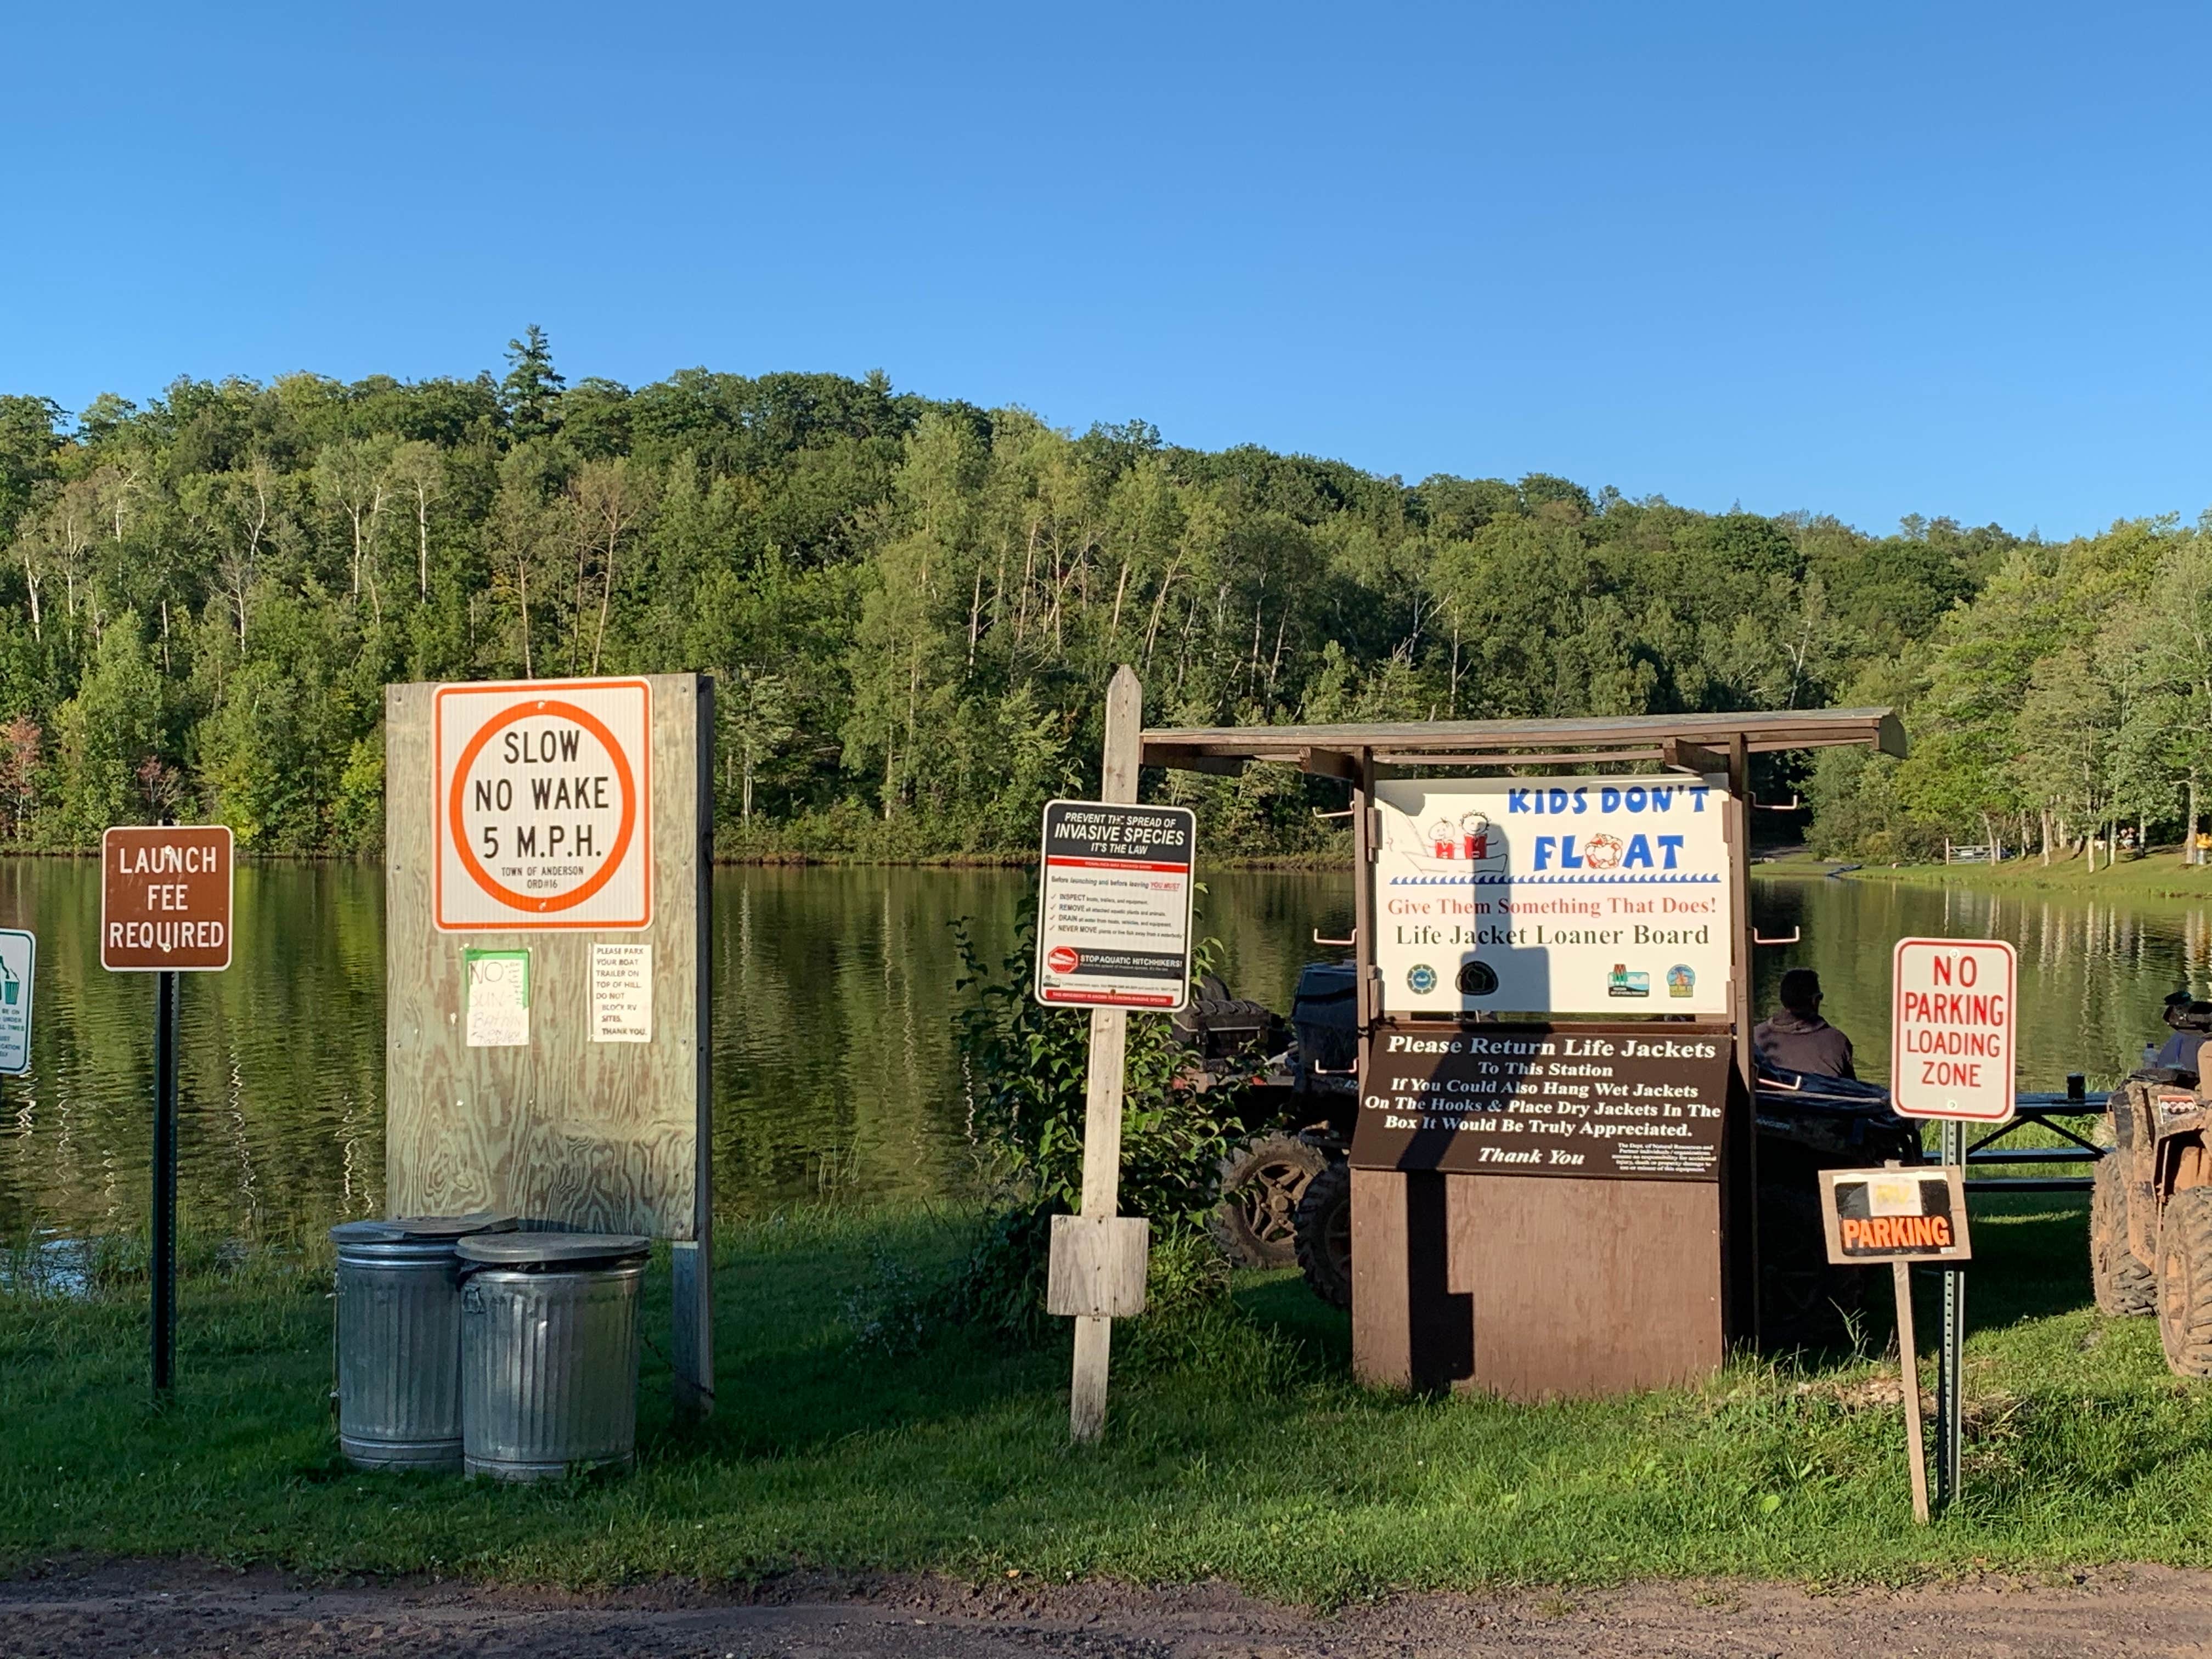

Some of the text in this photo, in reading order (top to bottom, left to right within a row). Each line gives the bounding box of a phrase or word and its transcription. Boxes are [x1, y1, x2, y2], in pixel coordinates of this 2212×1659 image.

[504, 730, 580, 764] SLOW
[476, 777, 610, 811] NO WAKE
[1509, 785, 1709, 814] KIDS DON'T
[1065, 812, 1105, 823] PREVENT
[1127, 816, 1162, 827] SPREAD
[1164, 818, 1176, 828] OF
[484, 825, 602, 859] 5 M.P.H.
[1054, 823, 1184, 845] INVASIVE SPECIES
[1091, 842, 1148, 854] IT'S THE LAW
[120, 847, 216, 873] LAUNCH
[502, 866, 584, 876] TOWN OF ANDERSON
[1070, 877, 1097, 886] launching
[148, 885, 188, 910] FEE
[1388, 897, 1716, 918] Give Them Something That Does!
[110, 922, 224, 949] REQUIRED
[1396, 924, 1709, 945] Life Jacket Loaner Board
[470, 961, 504, 984] NO
[1099, 956, 1131, 964] AQUATIC
[1132, 958, 1182, 967] HITCHHIKERS!
[1933, 955, 1977, 987] NO
[1905, 992, 2004, 1026] PARKING
[1386, 1035, 1716, 1058] Please Return Life Jackets
[1907, 1029, 2000, 1057] LOADING
[1478, 1062, 1613, 1077] To This Station
[1922, 1061, 1982, 1087] ZONE
[1391, 1077, 1699, 1098] If You Could Also Hang Wet Jackets
[1365, 1096, 1722, 1118] On The Hooks & Place Dry Jackets In The
[1384, 1115, 1692, 1138] Box It Would Be Truly Appreciated.
[1478, 1147, 1585, 1165] Thank You
[1843, 1216, 1950, 1248] PARKING
